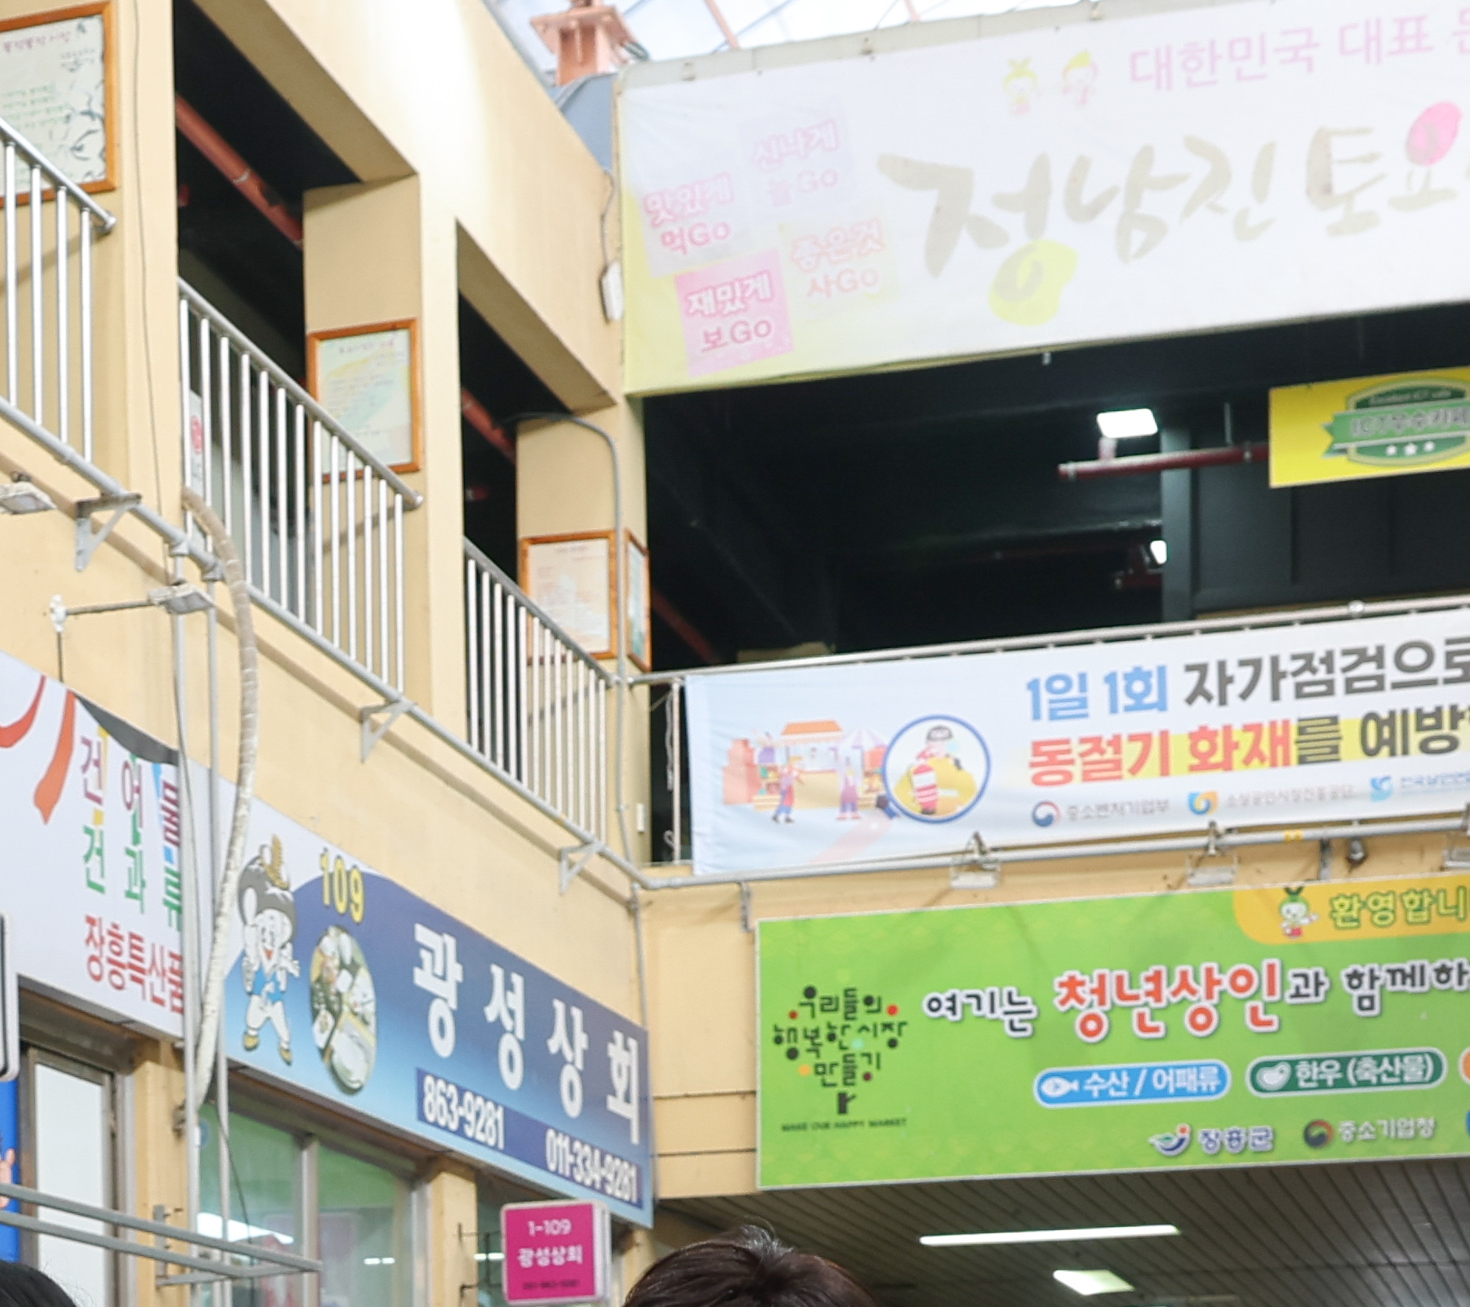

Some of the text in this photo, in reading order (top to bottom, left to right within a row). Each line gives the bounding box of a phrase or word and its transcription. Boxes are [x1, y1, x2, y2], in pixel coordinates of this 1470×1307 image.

[1129, 26, 1320, 91] 대한민국
[1338, 13, 1435, 65] 대표
[1026, 672, 1089, 721] 1일
[1107, 664, 1169, 715] 1회
[1028, 732, 1172, 788] 동절기
[1187, 714, 1343, 776] 화재를
[319, 848, 365, 924] 109
[84, 913, 184, 1015] 장흥특산품
[922, 987, 1037, 1036] 여기는
[1054, 957, 1329, 1041] 청년상인과
[413, 921, 640, 1146] 광성상회
[1081, 1067, 1130, 1099] 수산
[1152, 1064, 1221, 1095] 어패류
[1294, 1057, 1341, 1088] 한우
[1346, 1051, 1434, 1086] (축산물)
[422, 1074, 639, 1204] 863-9281 011-334-9281
[1337, 1117, 1436, 1143] 중소기업청
[517, 1244, 583, 1268] 광성상회
[527, 1218, 572, 1236] 1-109
